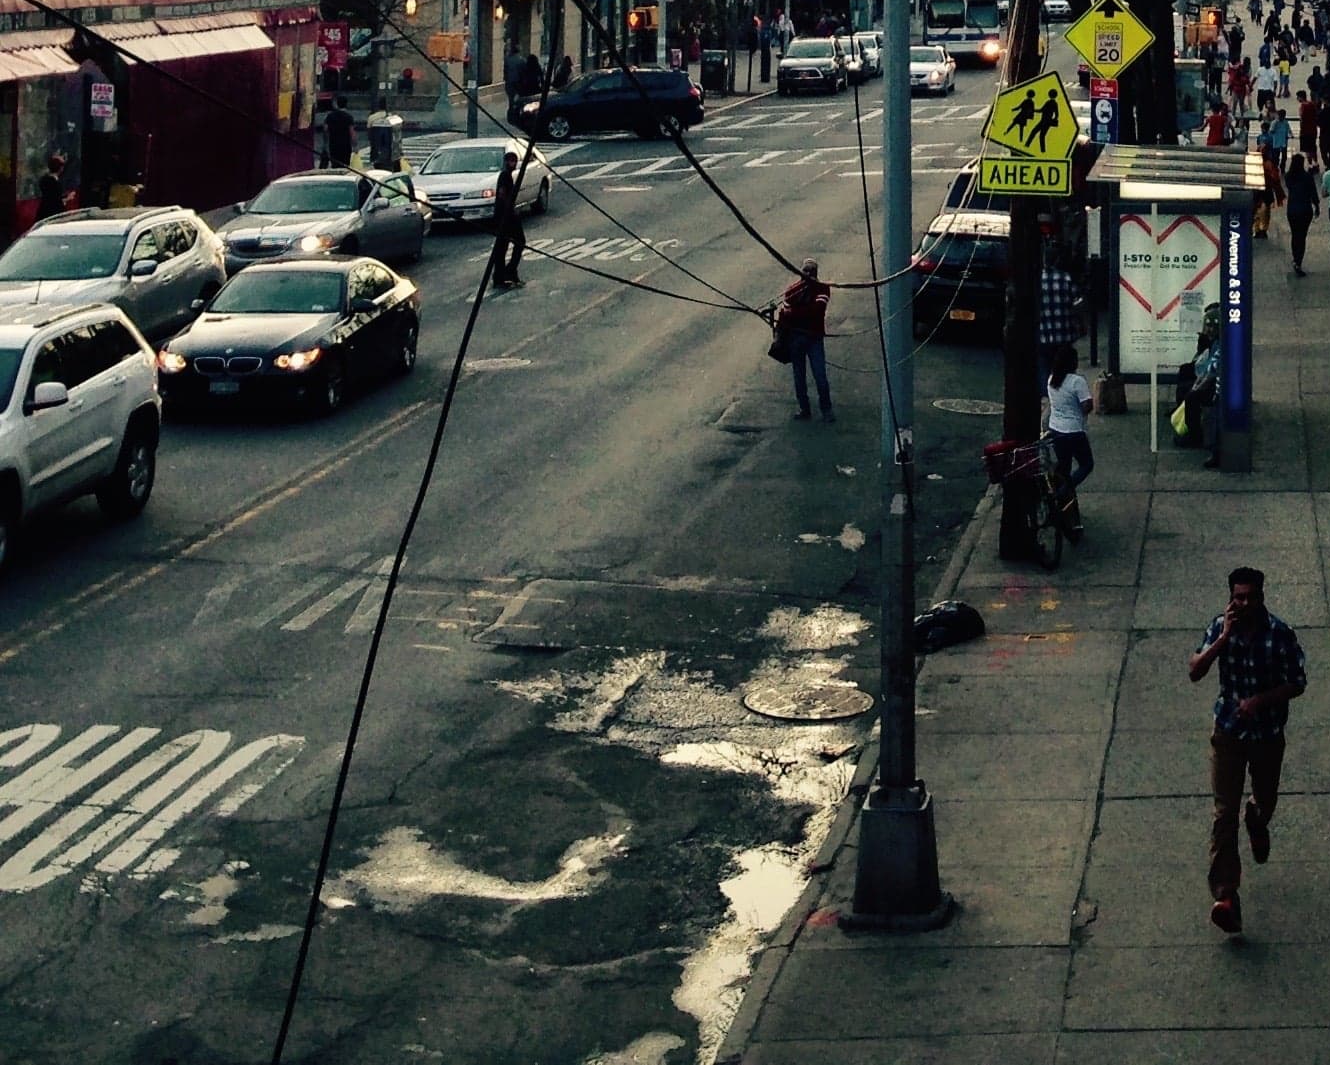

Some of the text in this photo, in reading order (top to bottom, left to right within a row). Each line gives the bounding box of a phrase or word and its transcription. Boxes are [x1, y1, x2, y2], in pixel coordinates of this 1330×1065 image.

[1098, 49, 1120, 62] 20
[989, 164, 1060, 186] AHEAD
[1123, 254, 1152, 263] I-STO
[1161, 254, 1171, 263] is
[1182, 254, 1199, 263] GO
[1229, 230, 1241, 276] Avenue
[1229, 278, 1241, 289] &
[1229, 290, 1241, 304] 31
[1229, 308, 1241, 324] St
